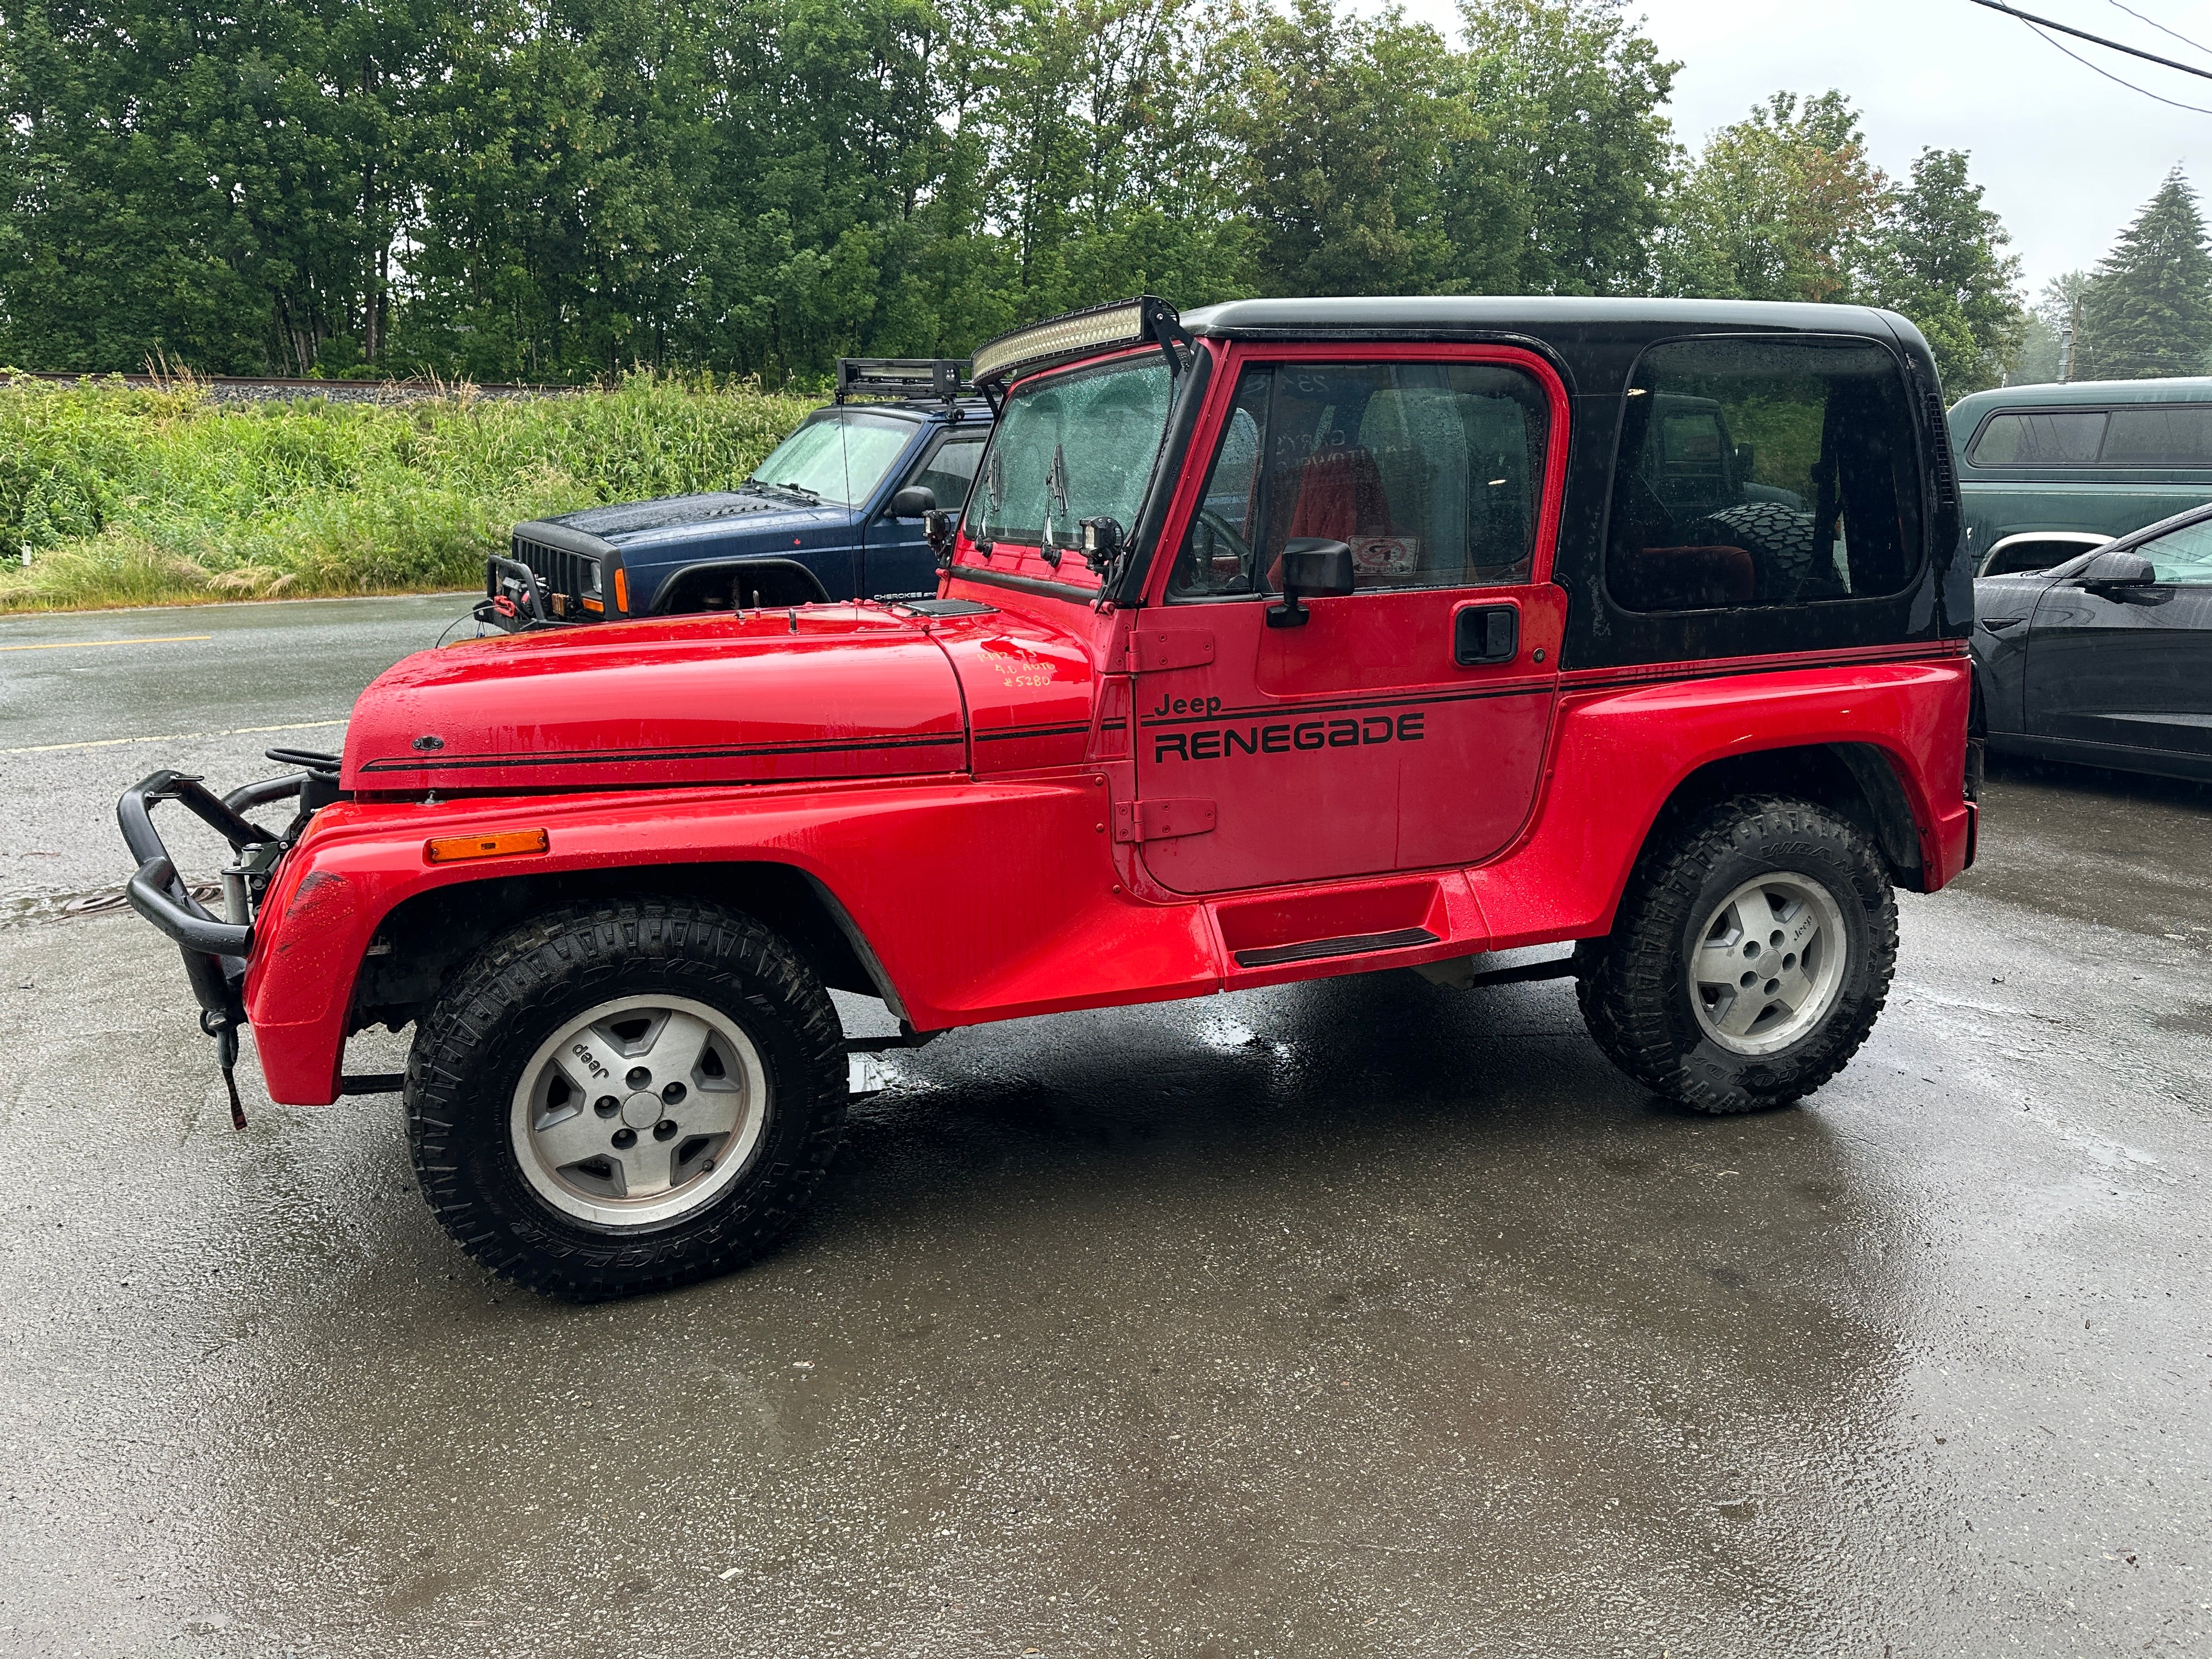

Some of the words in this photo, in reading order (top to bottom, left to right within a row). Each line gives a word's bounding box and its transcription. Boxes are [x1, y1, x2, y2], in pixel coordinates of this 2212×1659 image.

[873, 592, 922, 600] CHEROKEE
[977, 652, 1009, 663] 1992
[995, 664, 1017, 674] 4.0
[1022, 662, 1055, 672] AUTO
[1003, 675, 1051, 687] #5280
[1154, 694, 1222, 719] Jeep
[1760, 840, 1880, 975] WRANGLER
[1793, 915, 1813, 941] Jeep
[572, 1044, 609, 1080] Jeep
